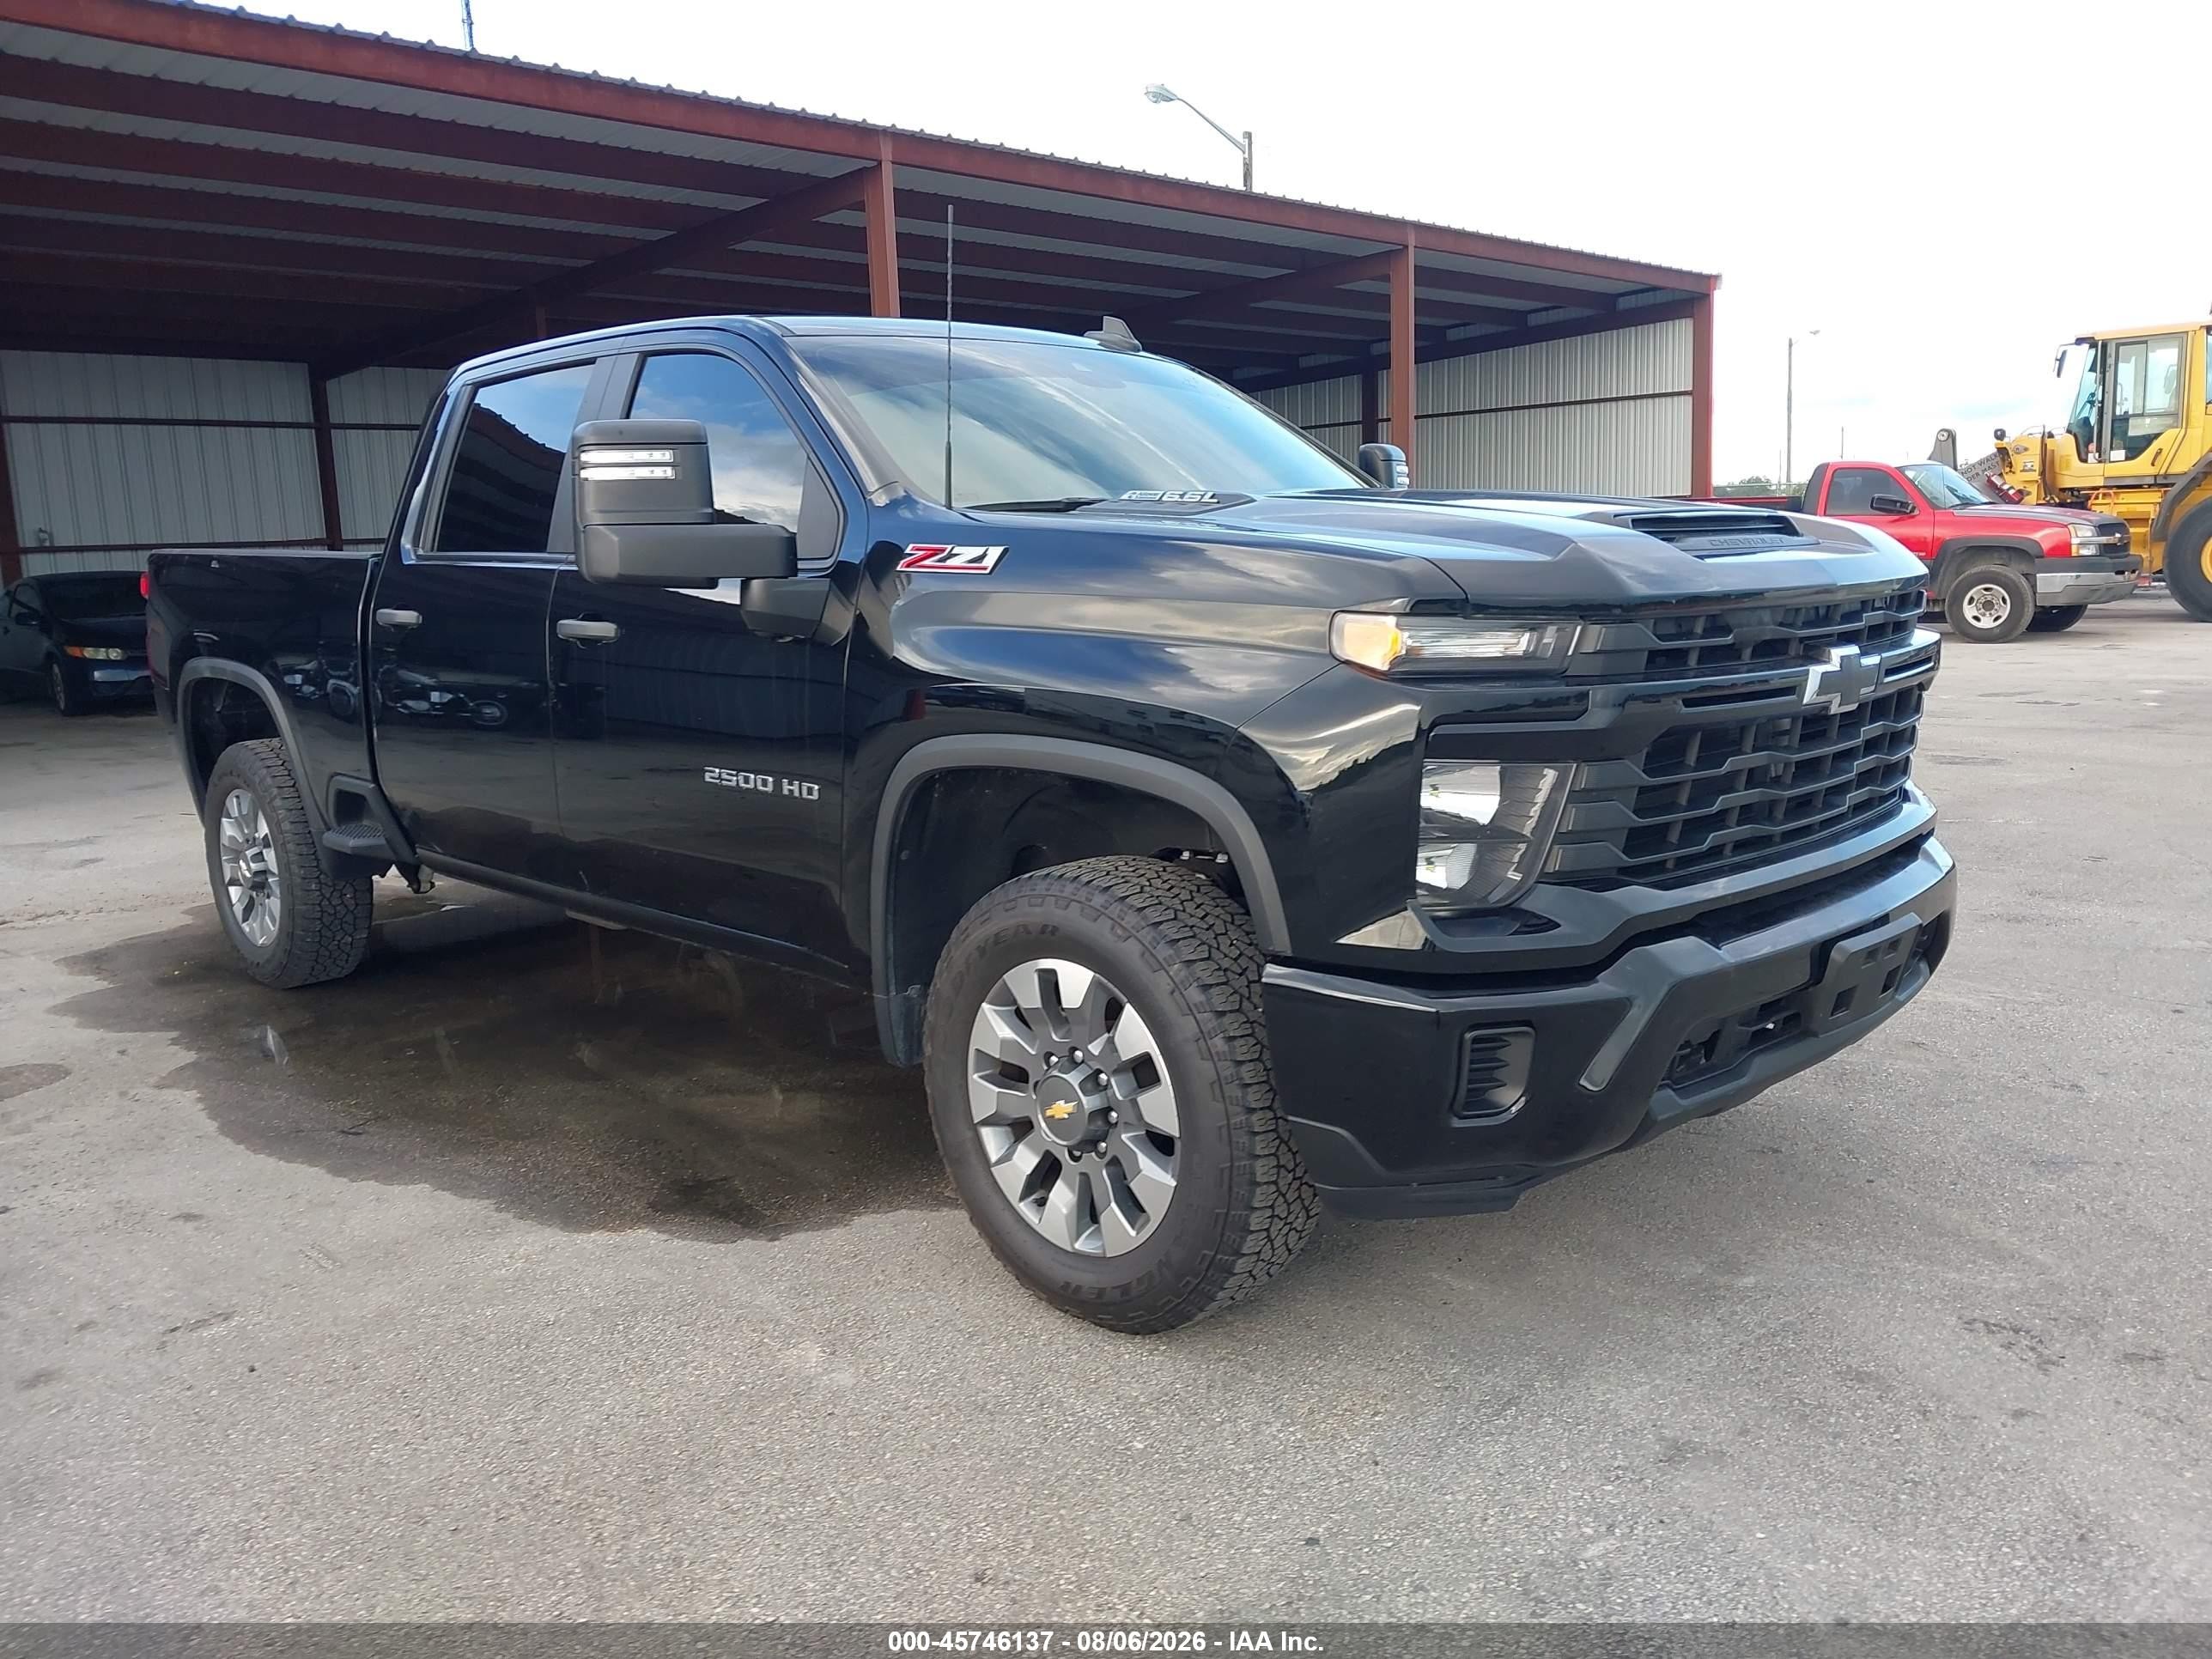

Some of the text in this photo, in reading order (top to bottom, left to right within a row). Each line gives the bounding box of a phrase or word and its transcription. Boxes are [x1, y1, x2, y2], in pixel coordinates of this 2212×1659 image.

[1961, 465, 1977, 477] NOT
[1160, 490, 1219, 503] 6.6L
[1710, 537, 1785, 547] CHEVROLET
[896, 543, 1009, 574] Z71
[703, 766, 821, 800] 2500 HD
